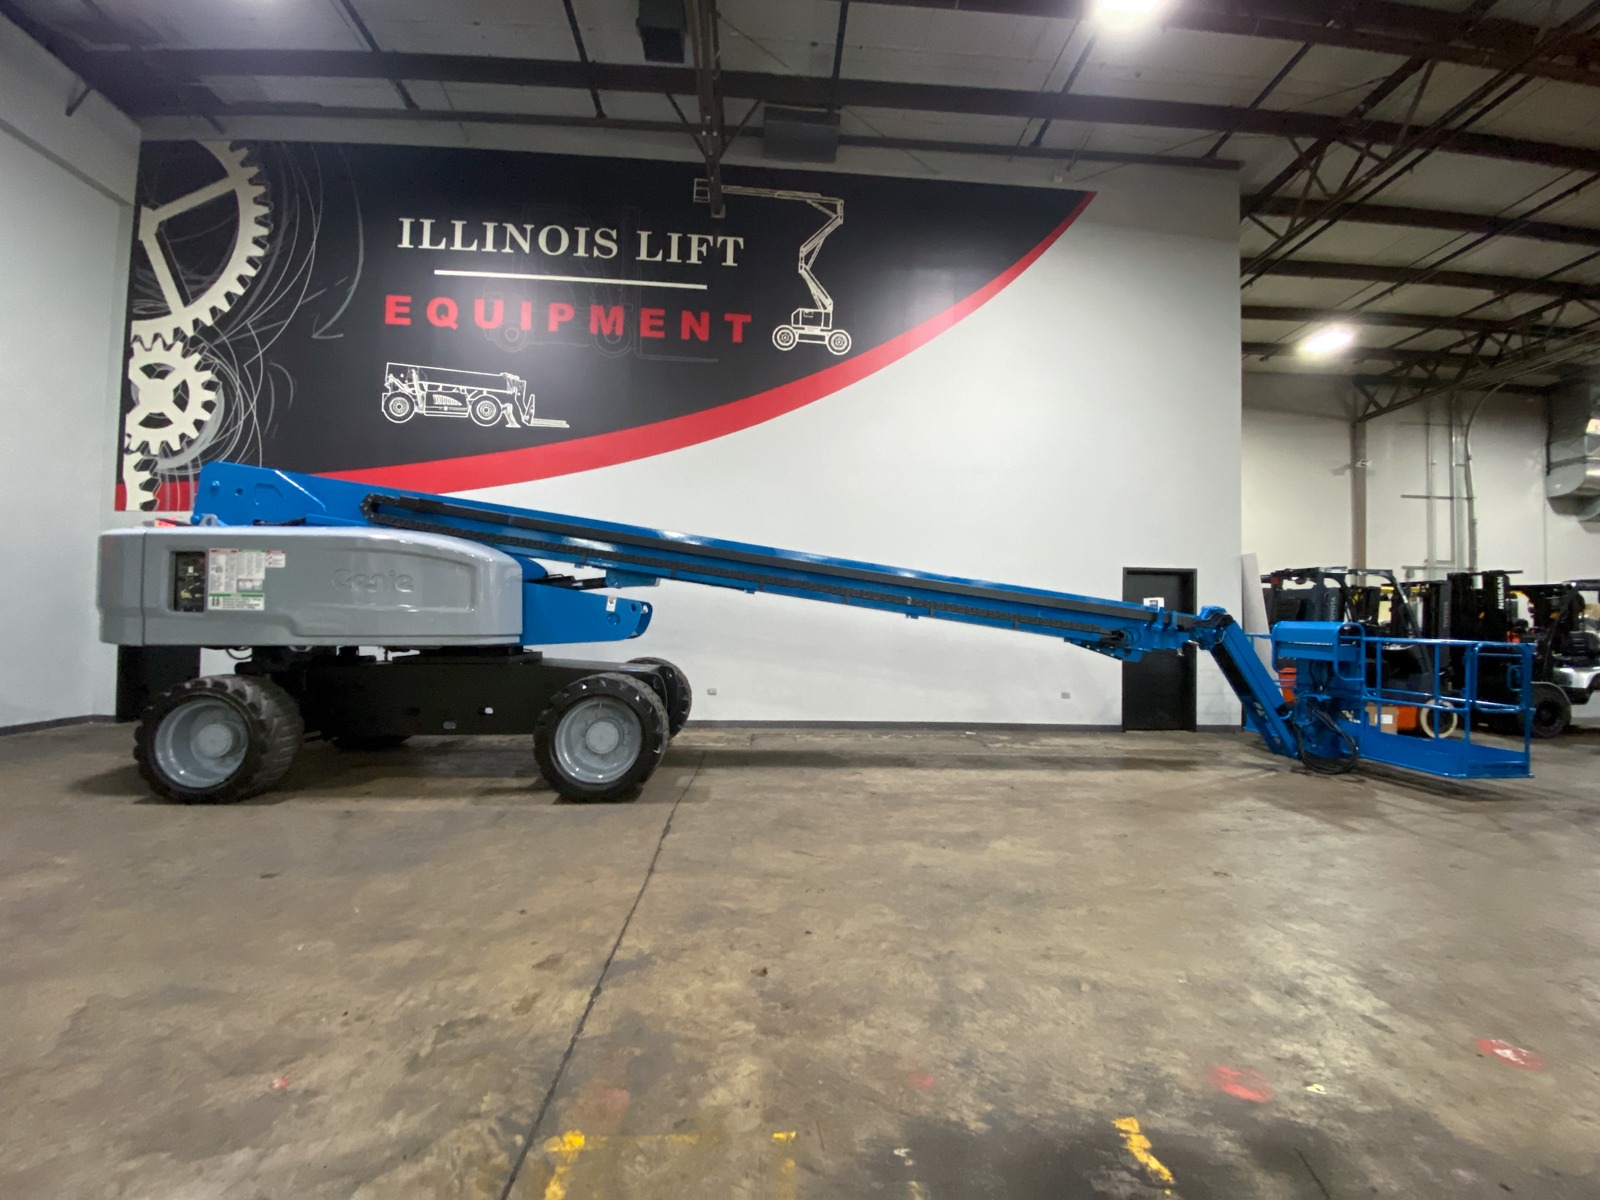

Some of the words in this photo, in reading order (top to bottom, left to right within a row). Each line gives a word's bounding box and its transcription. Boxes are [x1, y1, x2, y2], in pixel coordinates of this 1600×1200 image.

[397, 217, 619, 259] ILLINOIS
[635, 230, 745, 267] LIFT
[384, 295, 752, 344] EQUIPMENT
[331, 568, 414, 593] Genie
